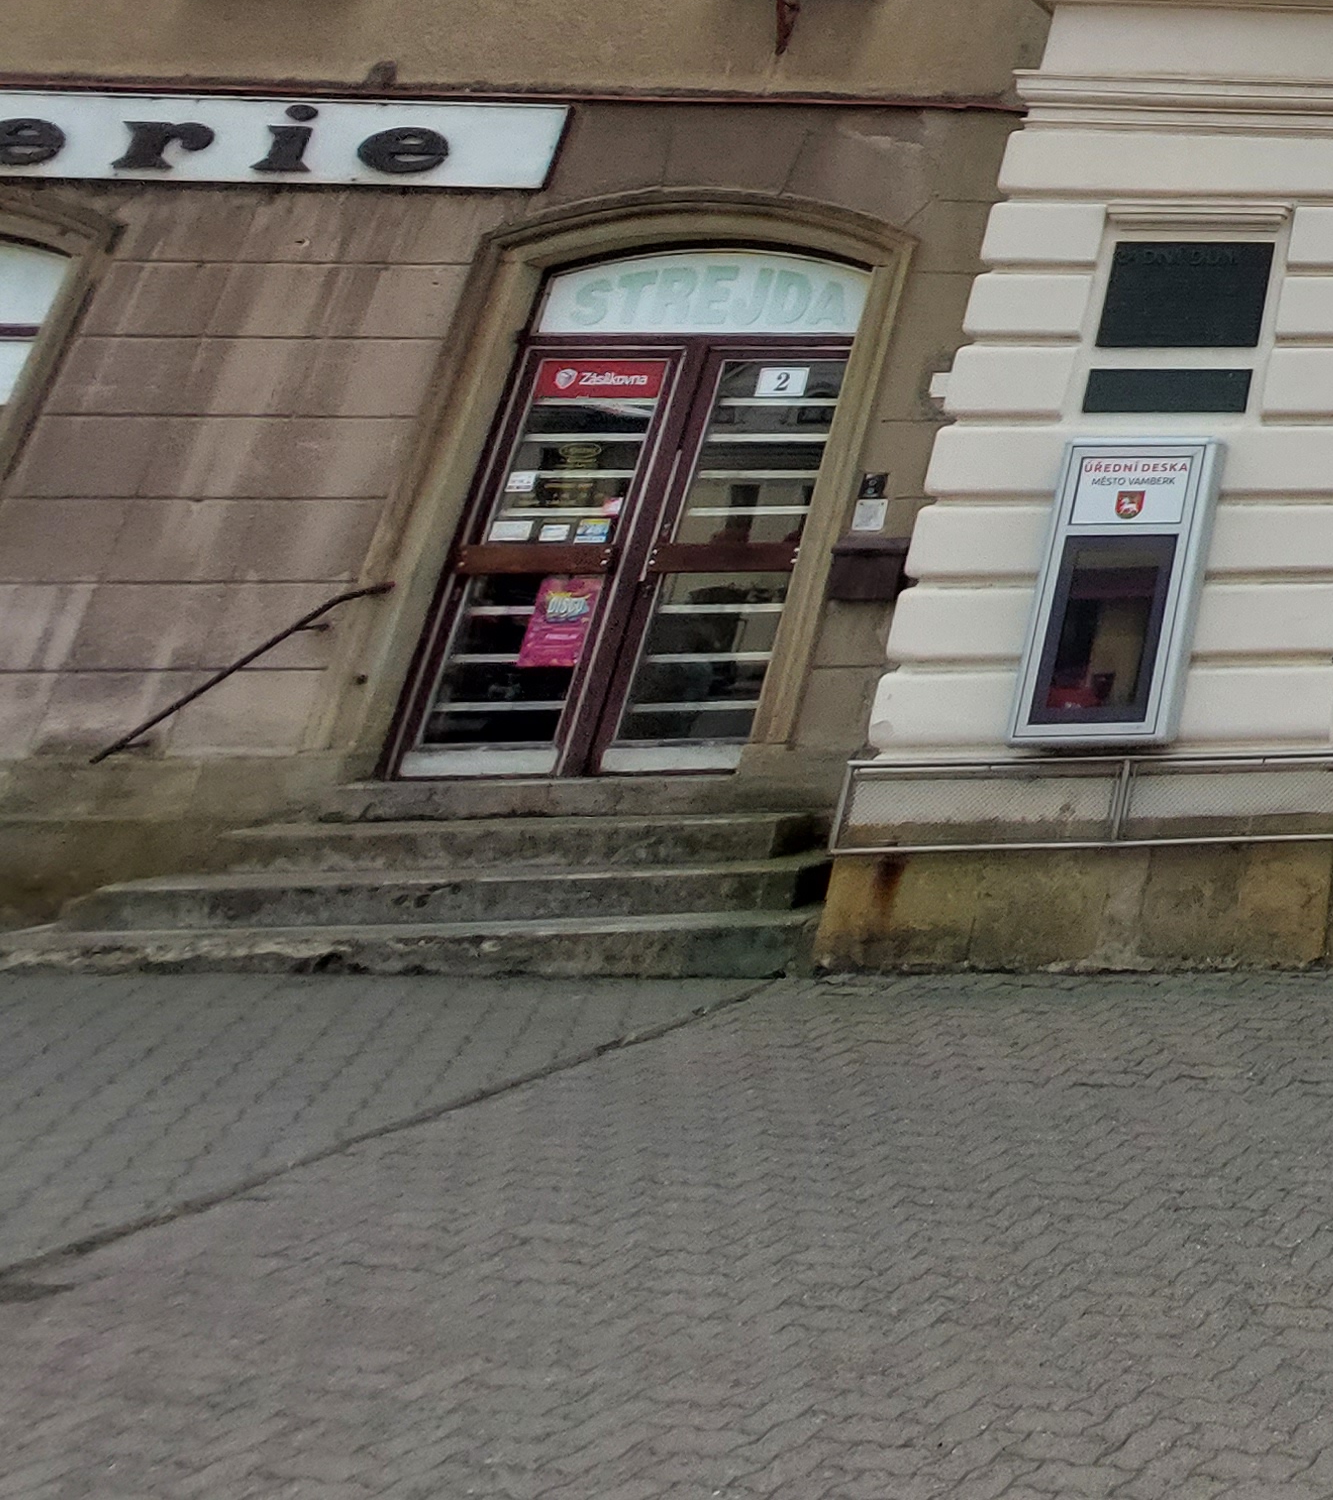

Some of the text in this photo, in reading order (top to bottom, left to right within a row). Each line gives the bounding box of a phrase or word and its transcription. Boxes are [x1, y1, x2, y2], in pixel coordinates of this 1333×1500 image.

[569, 265, 851, 326] STREJDA
[578, 370, 649, 387] Zásilkovna
[774, 371, 792, 392] 2
[1084, 461, 1188, 473] ÚŘEDNÍ DESKA
[1128, 476, 1176, 486] VAMBERK
